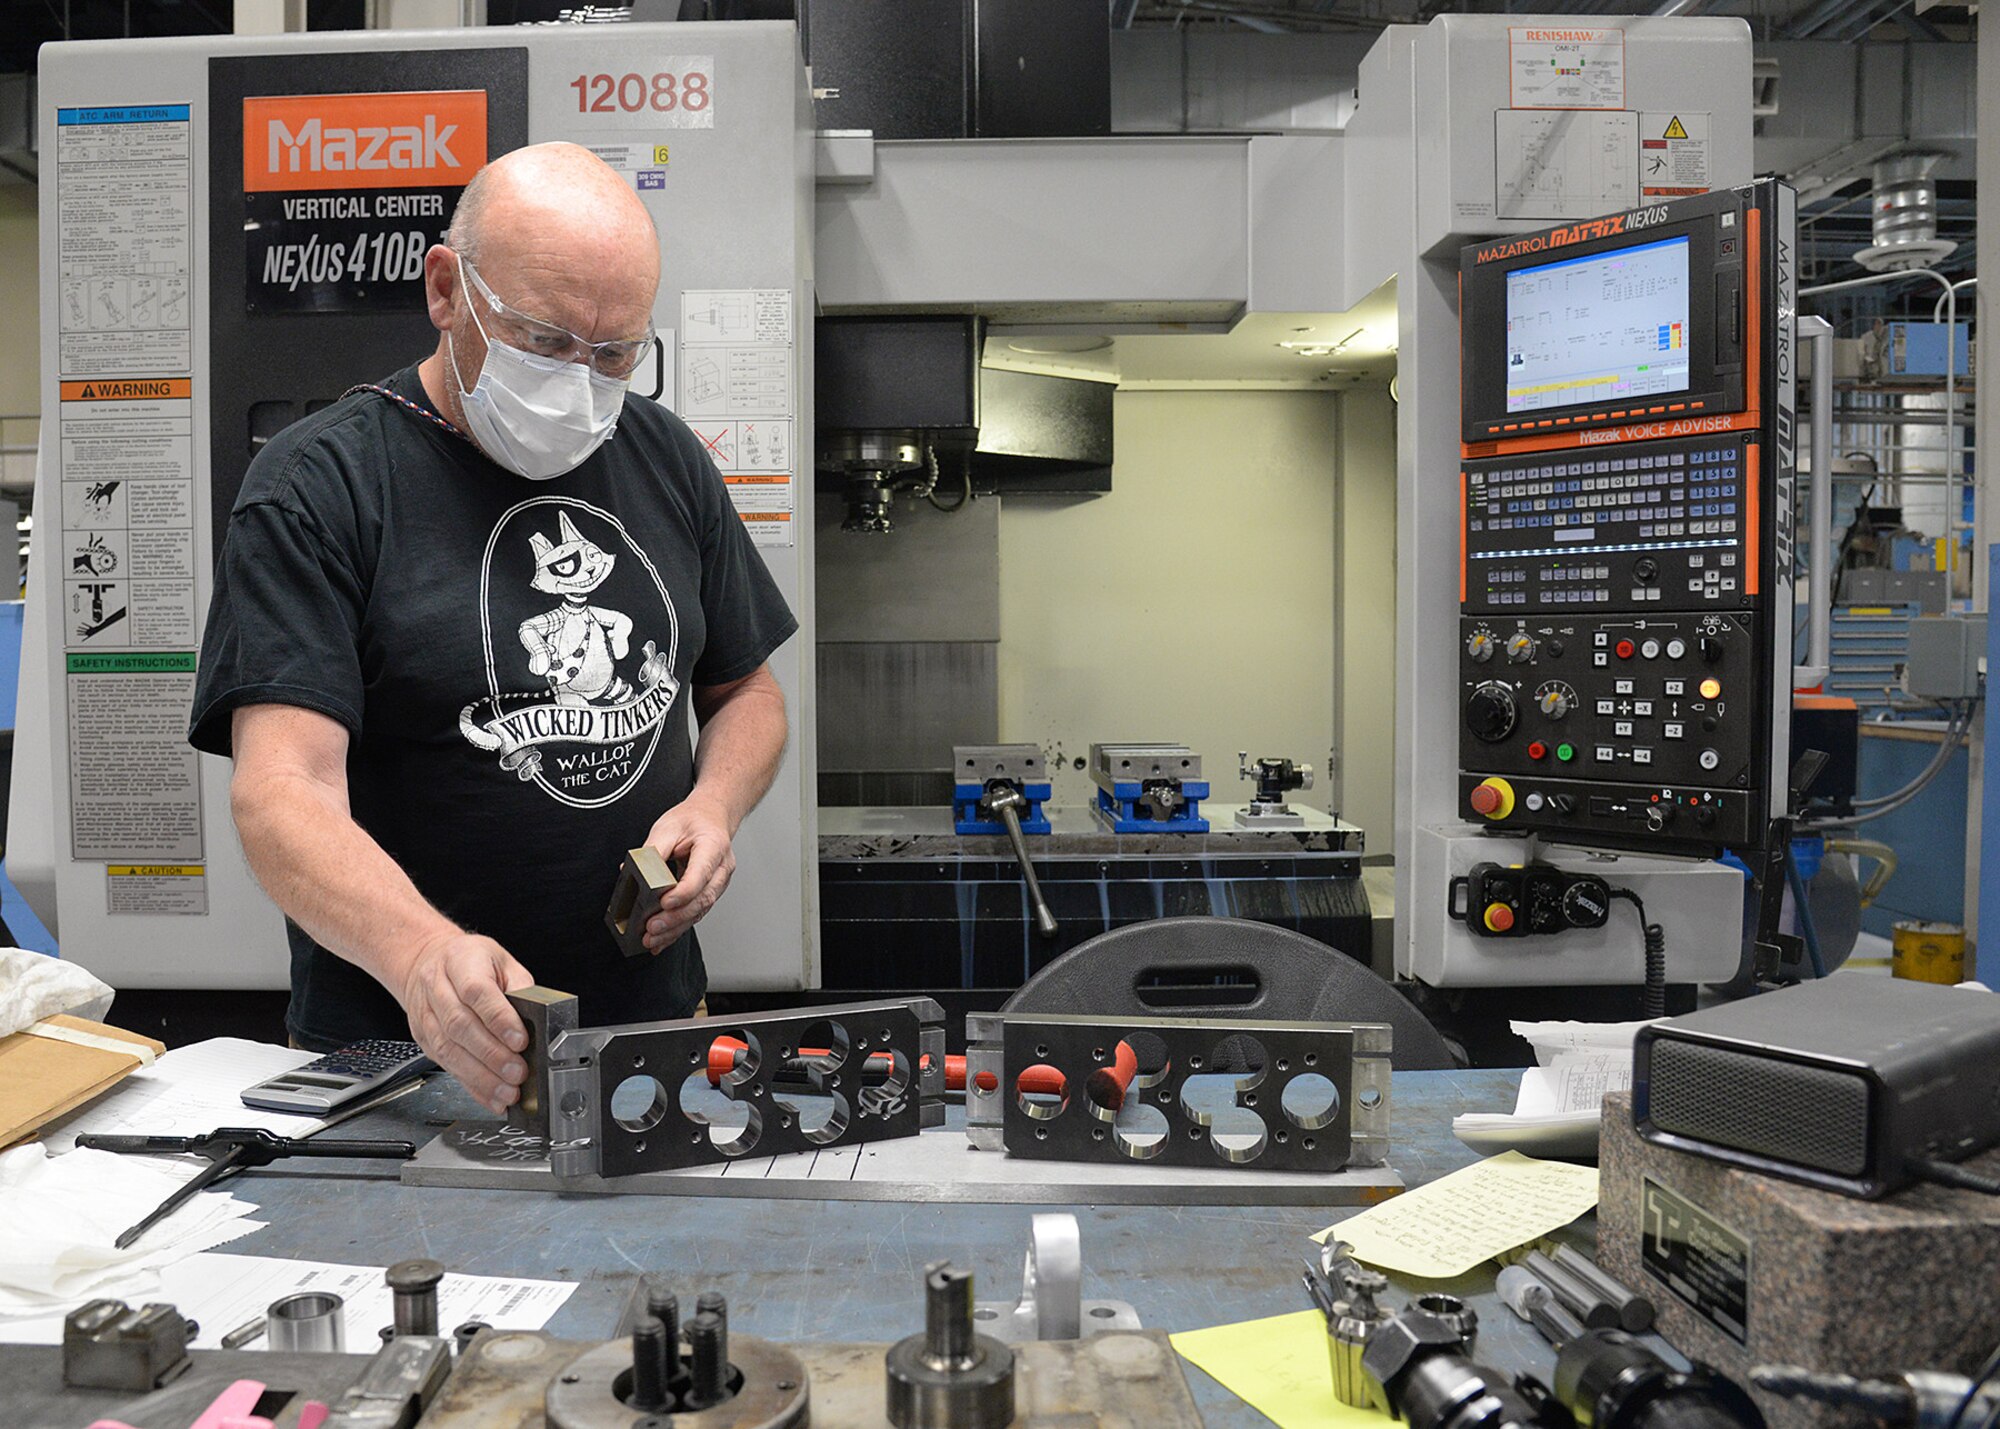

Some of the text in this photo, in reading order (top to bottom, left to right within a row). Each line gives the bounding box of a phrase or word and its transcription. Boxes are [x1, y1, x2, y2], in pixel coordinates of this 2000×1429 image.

[1526, 31, 1594, 41] RENISHAW
[570, 72, 710, 112] 12088
[80, 109, 169, 120] ATC ARM RETURN
[268, 115, 461, 173] Mazak
[283, 195, 444, 220] VERTICAL CENTER
[1477, 237, 1548, 264] MAZATROL
[1625, 206, 1669, 230] NEXUS
[262, 231, 426, 292] NEXUS 410B
[1777, 238, 1790, 389] MAZATROL
[98, 383, 170, 397] WARNING
[1580, 416, 1731, 444] Mazak VOICE ADVISER
[73, 658, 190, 668] SAFETY INSTRUCTIONS
[501, 679, 673, 744] WICKED TINKERS
[556, 742, 635, 771] WALLOP
[561, 761, 631, 788] THE CAT
